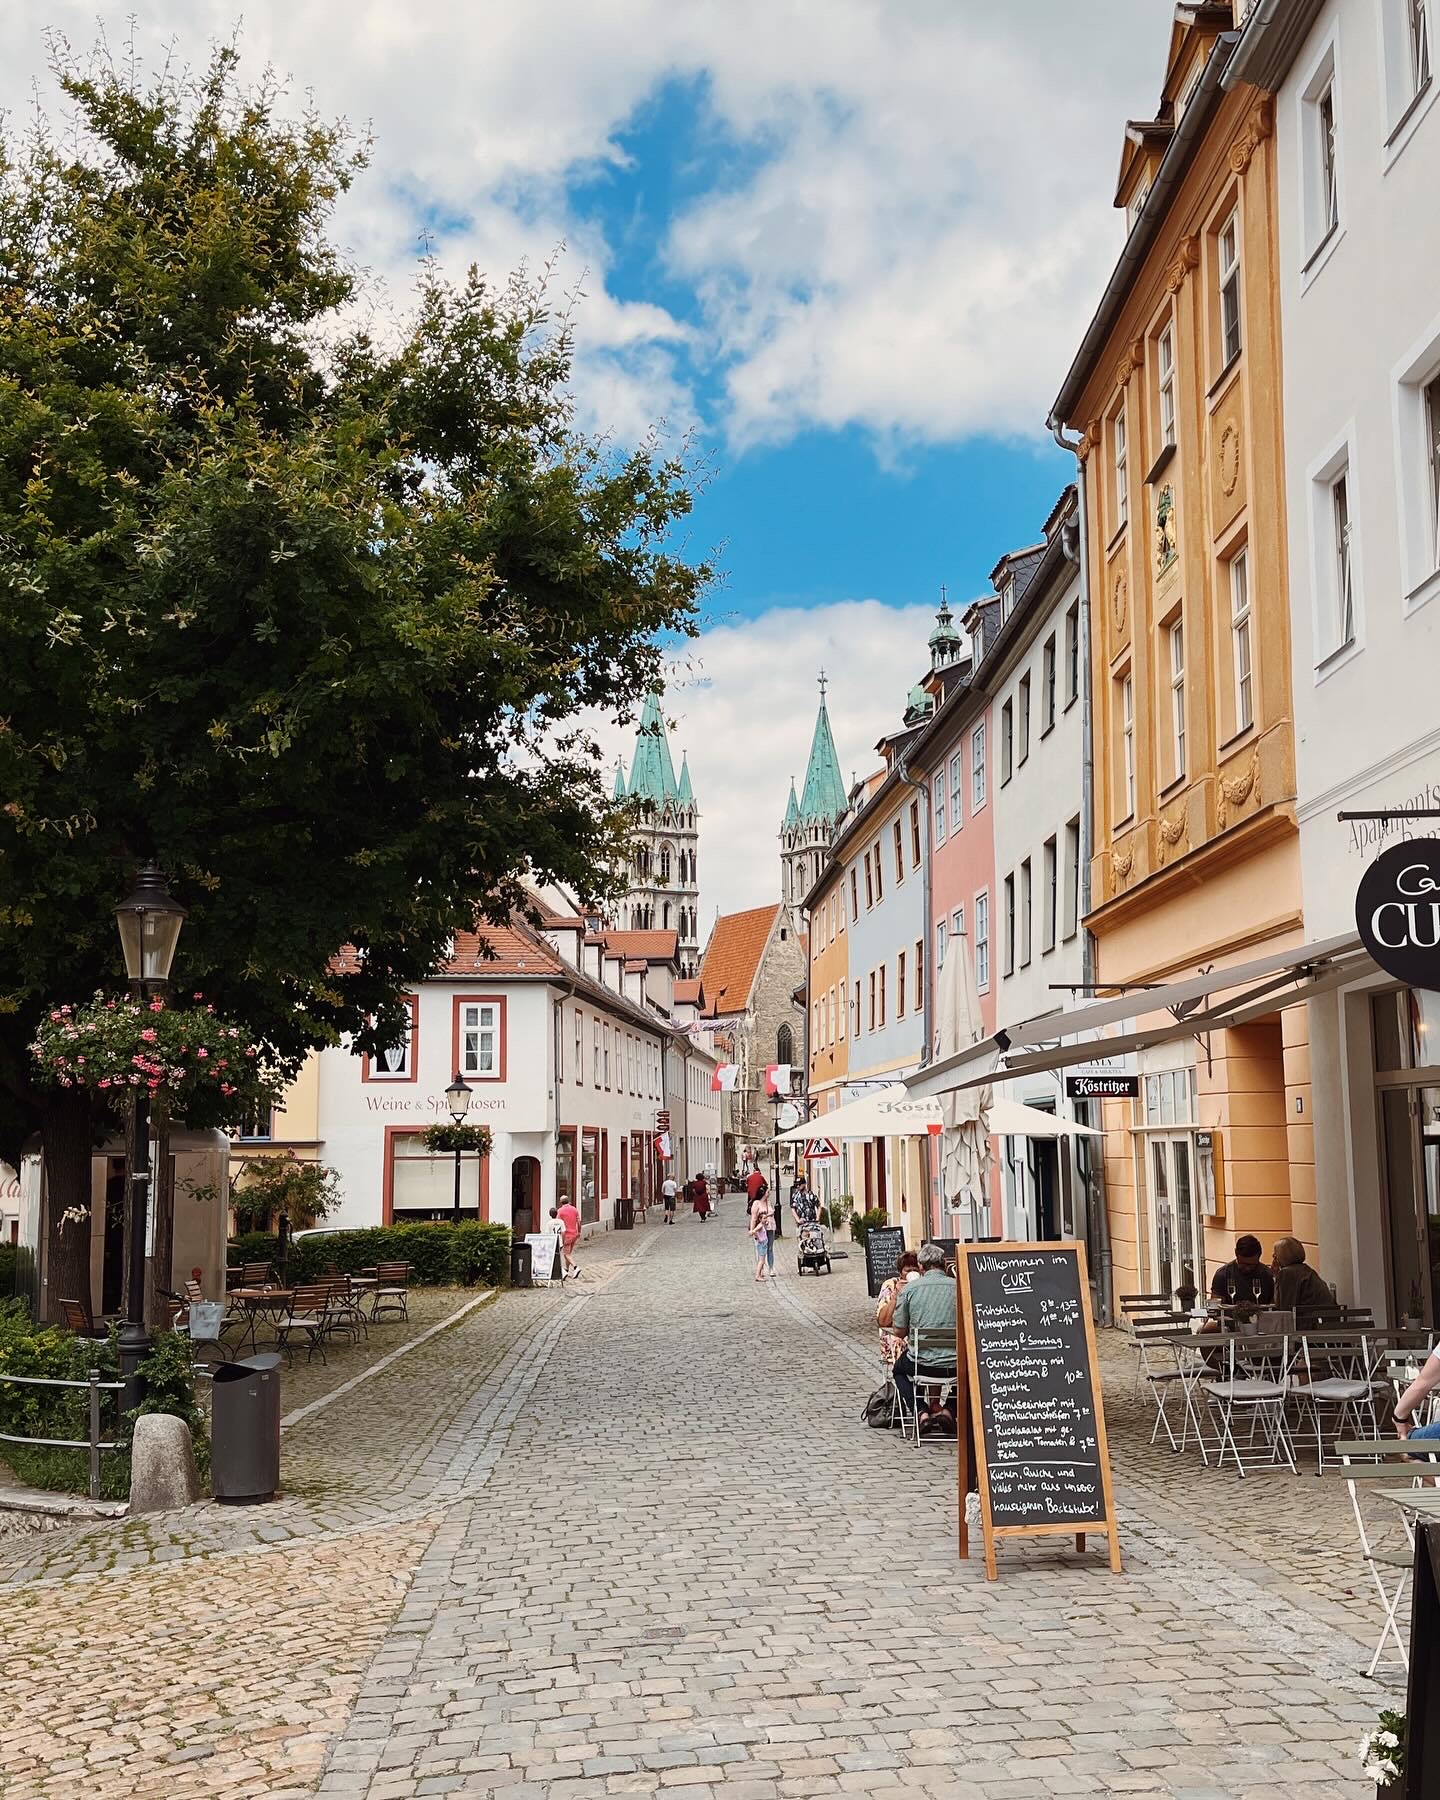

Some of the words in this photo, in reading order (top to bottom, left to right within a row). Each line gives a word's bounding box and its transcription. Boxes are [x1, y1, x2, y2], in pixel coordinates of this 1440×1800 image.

[1371, 902, 1440, 948] CU
[1075, 1078, 1130, 1095] Köstritzer
[366, 1096, 412, 1111] Weine
[415, 1102, 423, 1110] &
[974, 1256, 1044, 1272] Willkommen
[1052, 1255, 1067, 1264] im
[1001, 1271, 1035, 1287] CURT
[975, 1303, 1023, 1317] Frühstück
[977, 1318, 1027, 1333] Mittagstisch
[981, 1338, 1020, 1351] Samstag
[1019, 1332, 1027, 1343] &
[1027, 1335, 1062, 1348] Sonntag
[1050, 1356, 1064, 1365] mit
[1041, 1366, 1049, 1378] &
[990, 1382, 1031, 1396] Baguette
[1060, 1398, 1075, 1408] mit
[1044, 1426, 1057, 1434] mit
[1033, 1436, 1068, 1447] Tomaten
[1069, 1436, 1076, 1446] &
[996, 1449, 1019, 1460] Feta
[1023, 1466, 1054, 1479] Quiche
[1057, 1468, 1075, 1478] und
[991, 1482, 1013, 1494] vieles
[1017, 1482, 1037, 1492] mehr
[1041, 1482, 1061, 1492] aus
[1064, 1483, 1096, 1493] unserer
[993, 1501, 1044, 1515] hauseigenen
[1044, 1497, 1099, 1515] Backstube!
